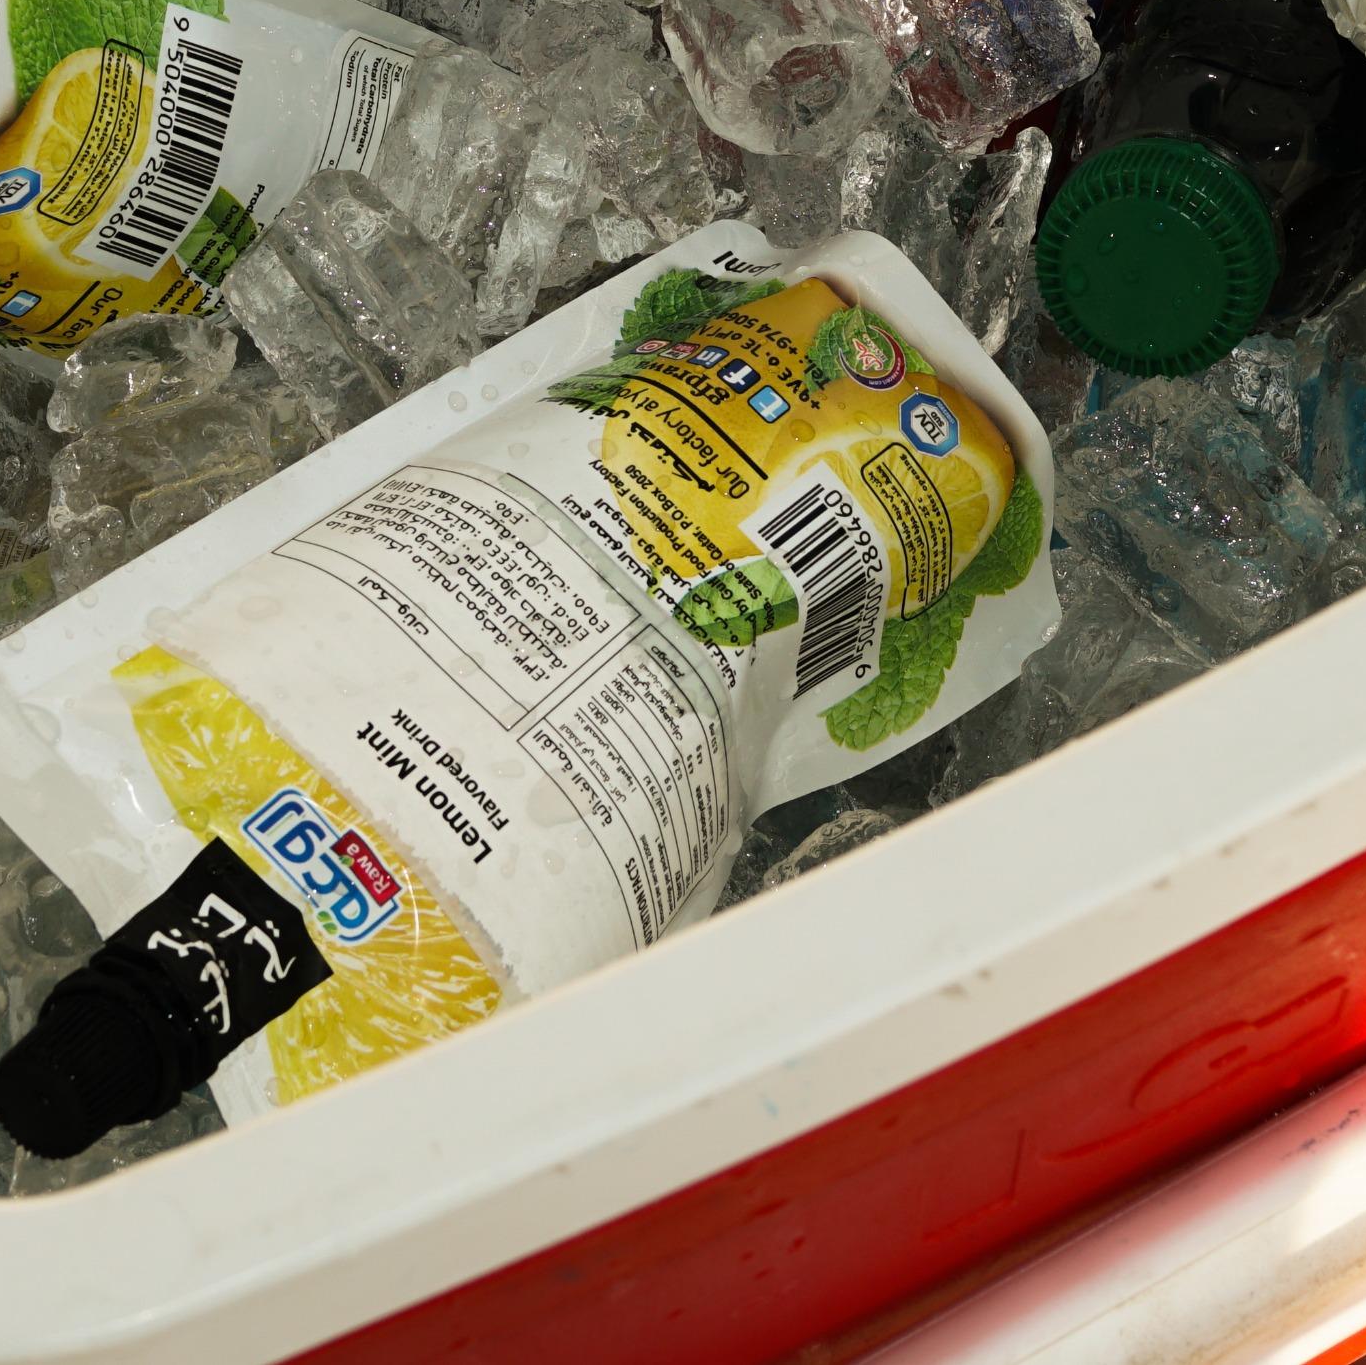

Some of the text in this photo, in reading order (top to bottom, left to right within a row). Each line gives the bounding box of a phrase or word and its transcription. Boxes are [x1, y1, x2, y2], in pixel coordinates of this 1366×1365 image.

[379, 61, 393, 100] Protein
[392, 65, 403, 83] Fat
[94, 90, 110, 124] below
[354, 55, 383, 155] Total Carbohydrate
[94, 119, 113, 151] below
[96, 13, 192, 241] 9 504000 286460
[350, 117, 363, 143] Sugars
[75, 143, 96, 168] after
[45, 168, 82, 205] opening
[210, 202, 241, 239] Doha,
[226, 182, 268, 241] Produced
[189, 236, 219, 268] State
[215, 239, 234, 256] by
[178, 265, 198, 282] of
[196, 254, 223, 281] Gulf
[86, 283, 124, 320] Our
[152, 277, 187, 312] Qatar,
[173, 277, 204, 308] Food
[754, 319, 803, 361] +974
[631, 391, 662, 419] at
[651, 401, 720, 471] factory
[622, 461, 655, 492] 2050
[709, 458, 753, 503] Our
[897, 452, 931, 492] opening
[647, 485, 695, 532] P.O.Box
[924, 493, 942, 517] after
[585, 455, 754, 618] by Gulf Food Production Factory
[686, 524, 726, 563] Qatar,
[926, 519, 938, 548] below
[632, 535, 667, 569] دولة
[716, 555, 739, 573] of
[407, 549, 458, 598] منظم
[451, 562, 510, 620] مطابقة
[484, 567, 523, 605] مواد
[730, 568, 764, 601] State
[822, 488, 883, 679] 9 504000 286460
[595, 687, 626, 717] دهون
[606, 676, 637, 706] بروتين
[583, 698, 611, 727] طاقة
[530, 727, 577, 774] القيمة
[385, 706, 512, 833] Flavored Drink
[349, 720, 494, 865] Lemon Mint
[257, 800, 380, 918] روعة
[622, 856, 644, 892] FACTS
[645, 857, 659, 886] serving
[654, 841, 669, 872] package
